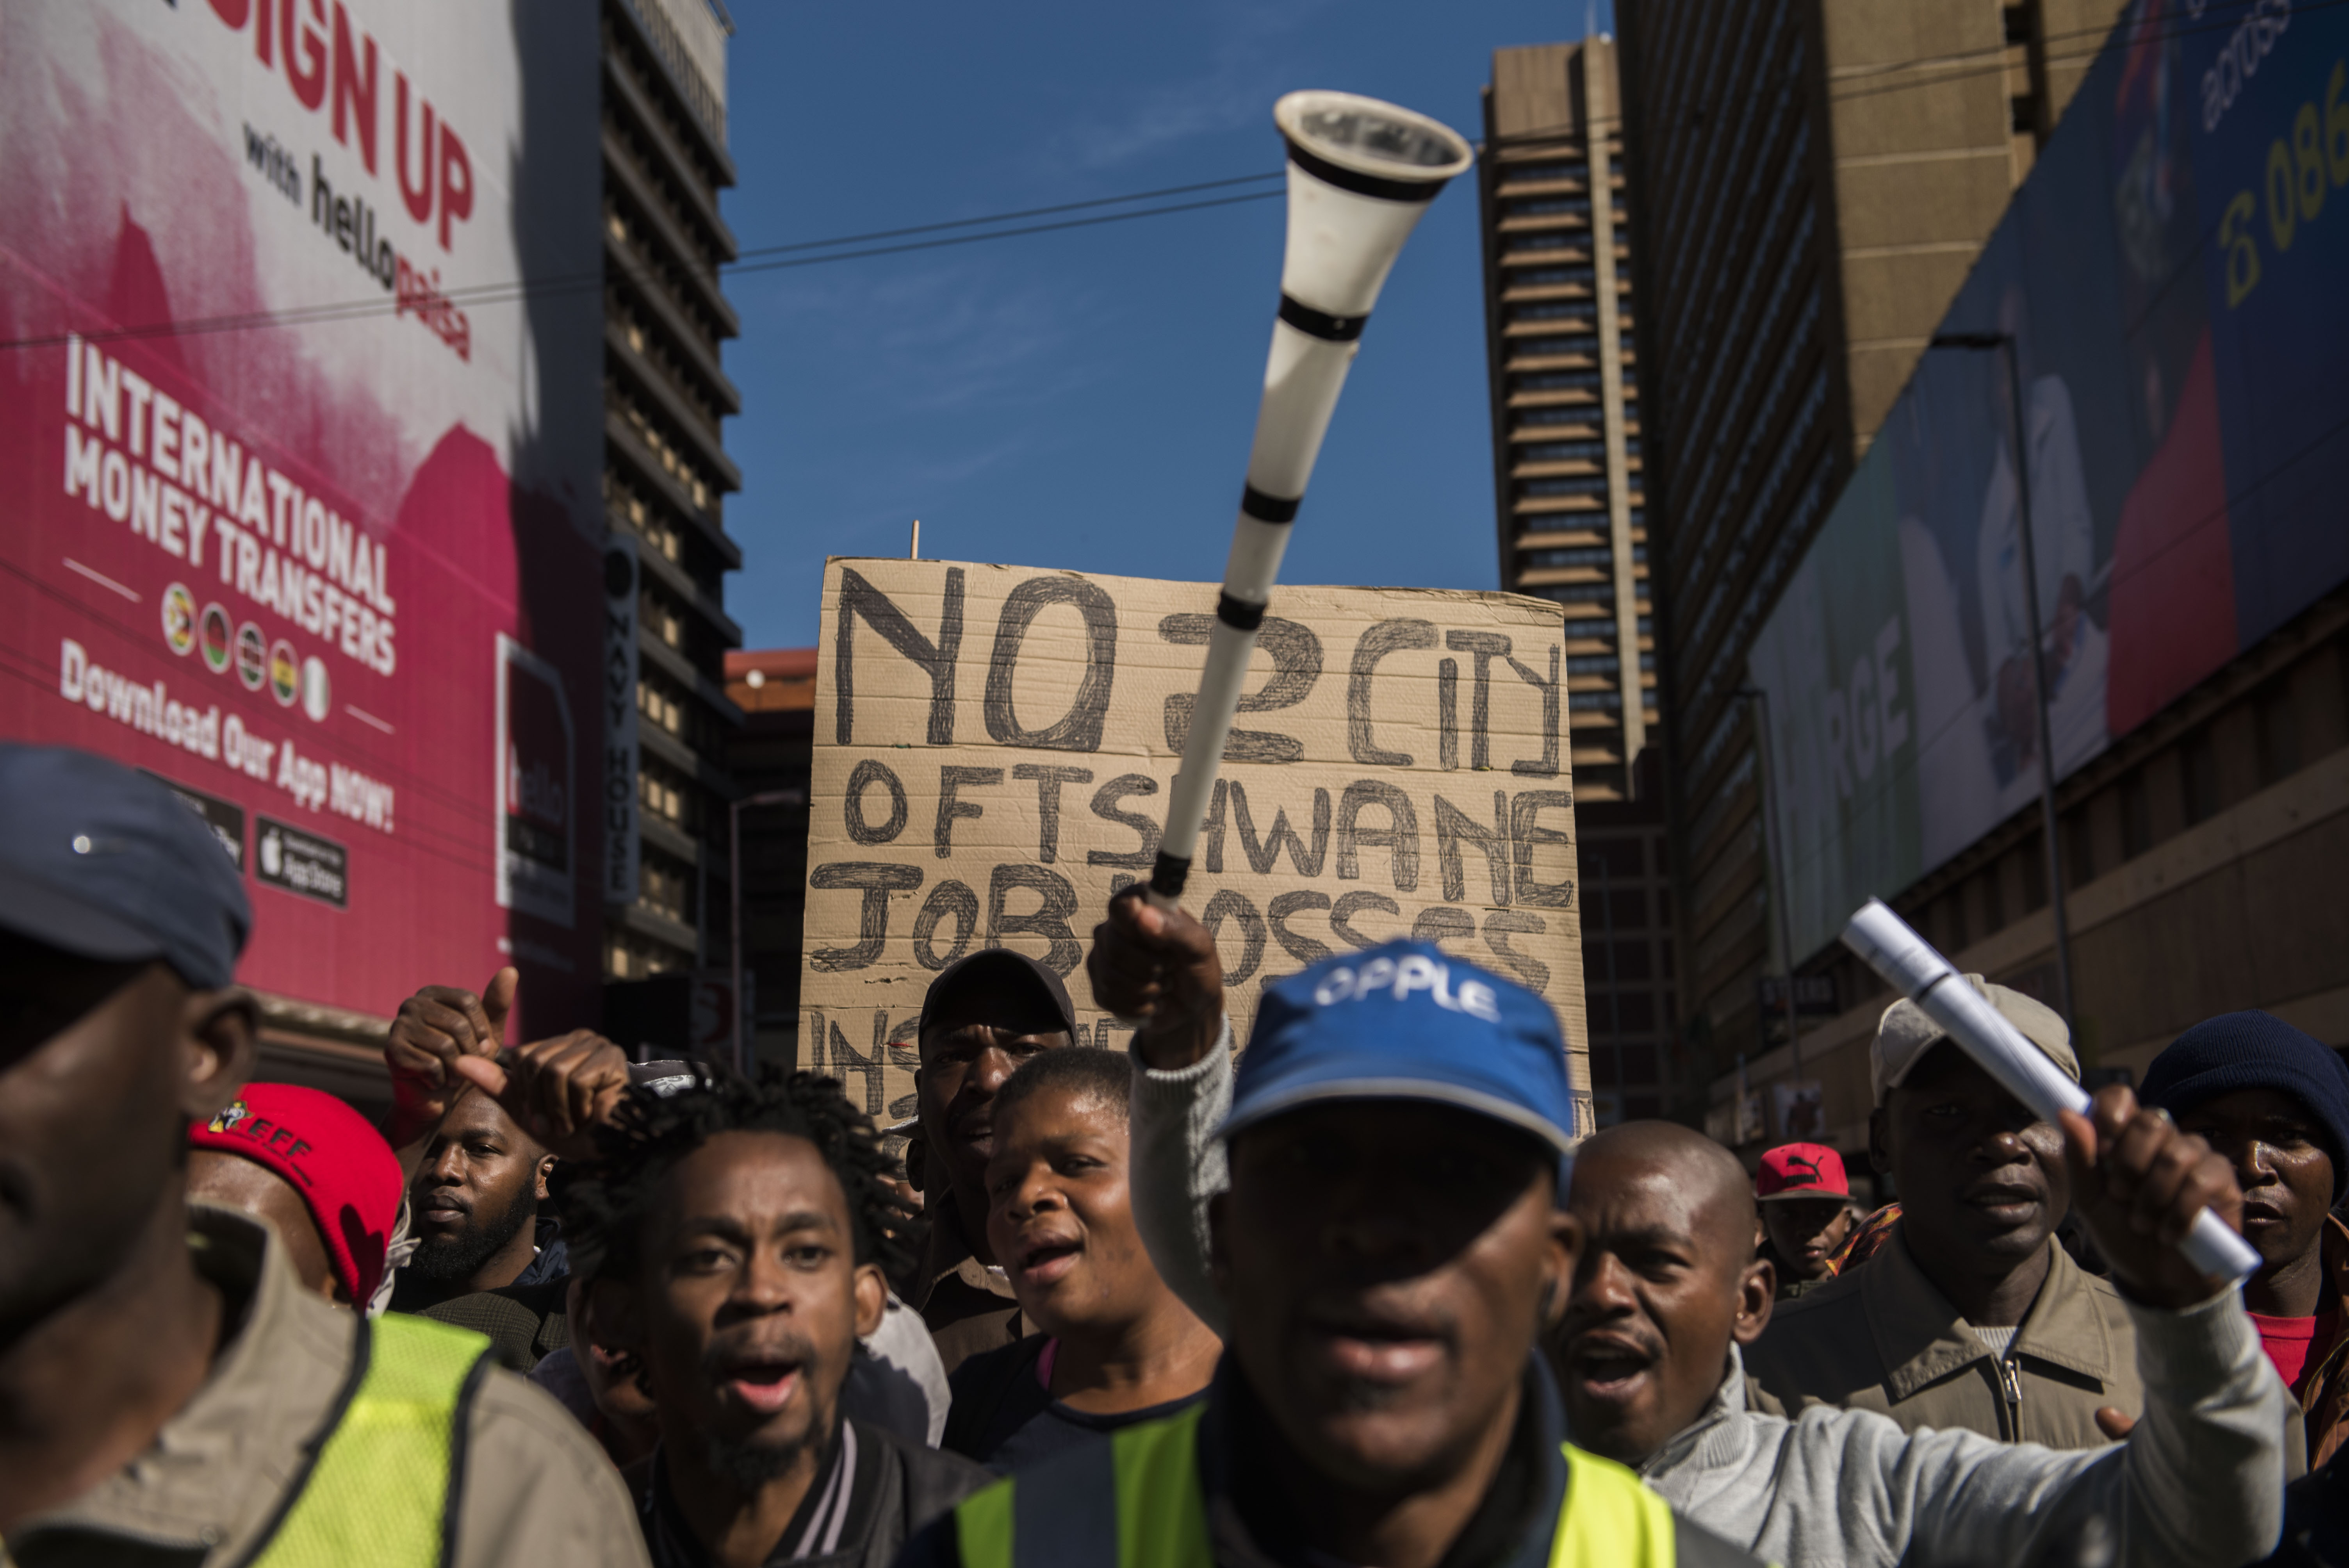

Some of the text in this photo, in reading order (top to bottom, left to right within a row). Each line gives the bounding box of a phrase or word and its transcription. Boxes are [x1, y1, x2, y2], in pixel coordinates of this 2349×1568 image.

[243, 122, 301, 208] with
[395, 69, 473, 254] UP
[64, 422, 396, 677] MONEY TRANSFERS
[66, 330, 396, 617] INTERNATIONAL
[60, 637, 395, 832] Download Our App NOW!
[835, 567, 1560, 779] NO 2 CITY
[607, 747, 630, 891] HOUSE
[844, 759, 1005, 859] OF
[809, 861, 1084, 979] JOB
[248, 1118, 311, 1157] EFF
